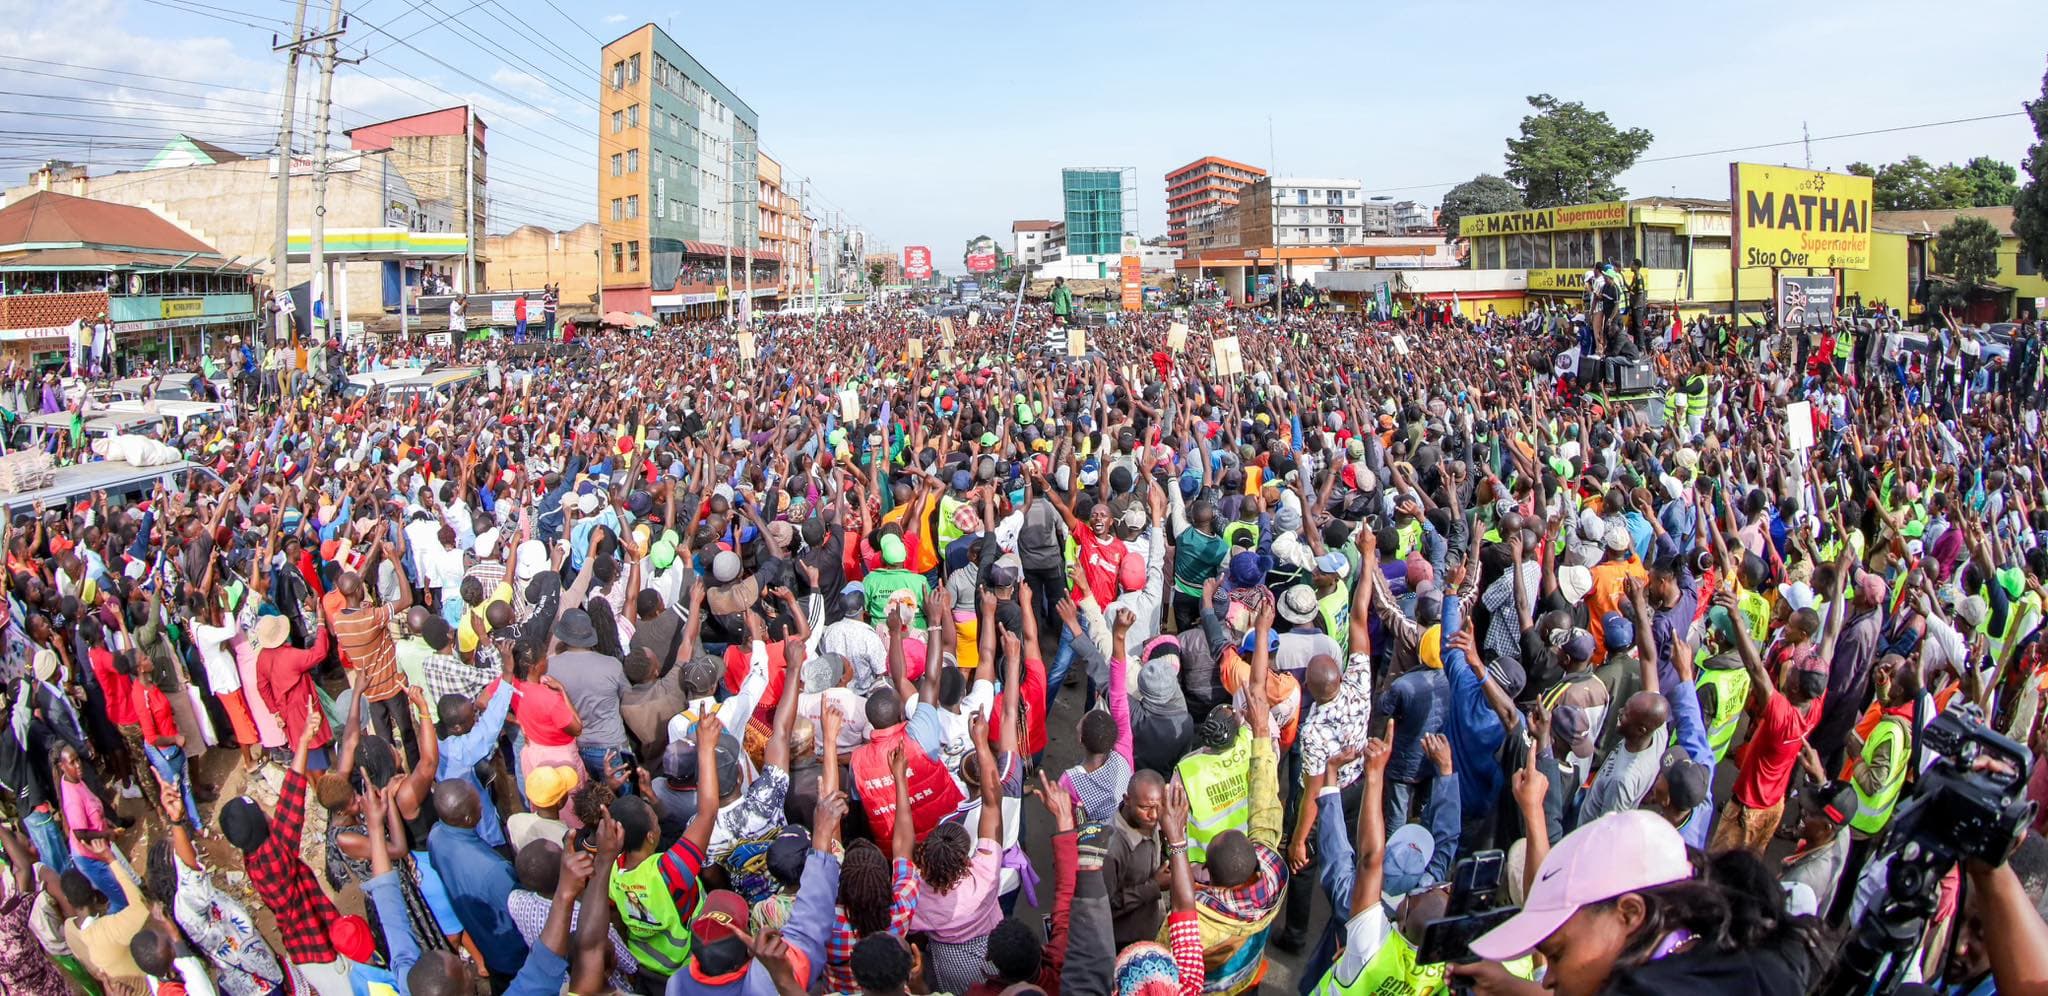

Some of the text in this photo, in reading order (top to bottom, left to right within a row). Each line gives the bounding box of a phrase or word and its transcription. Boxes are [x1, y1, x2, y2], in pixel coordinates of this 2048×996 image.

[1487, 203, 1625, 233] MATHAI Supermarket
[1747, 190, 1868, 234] MATHAI
[1801, 232, 1867, 254] Supermarket
[1748, 247, 1809, 267] Stop Over
[1206, 774, 1244, 797] GITHINJI
[1210, 785, 1245, 806] TROPICAL
